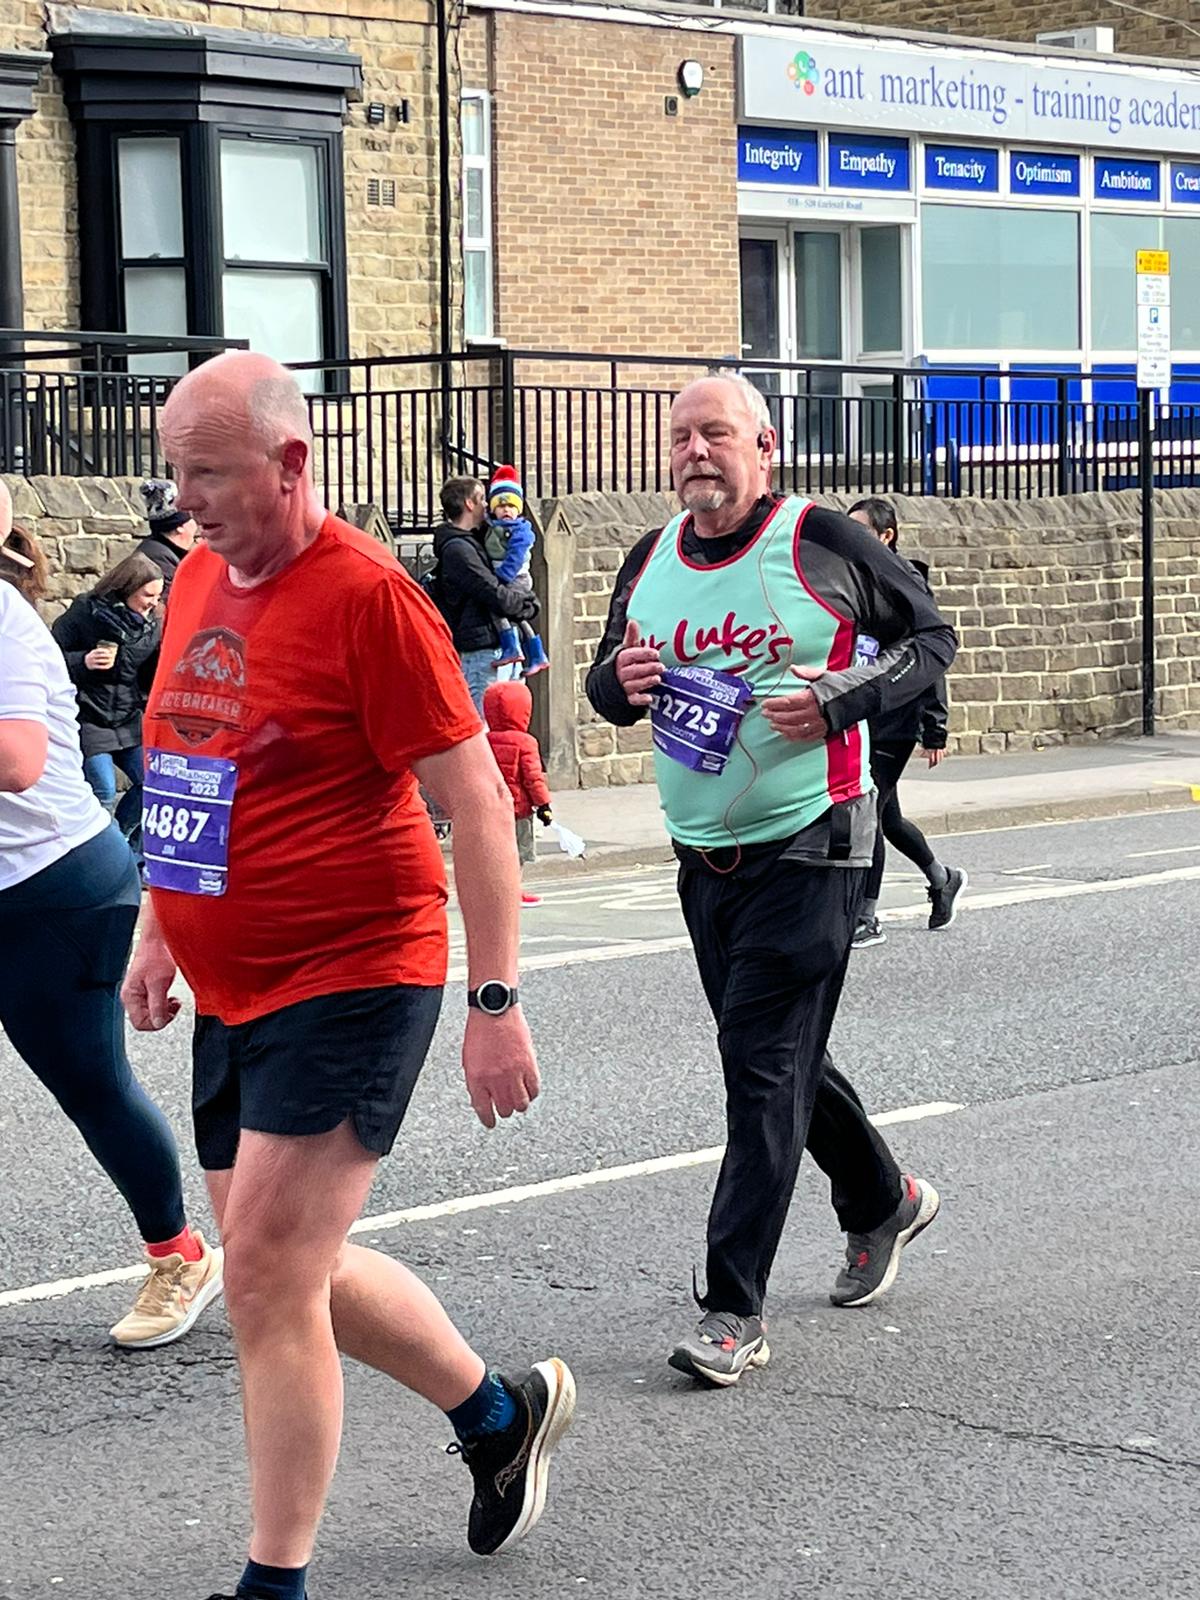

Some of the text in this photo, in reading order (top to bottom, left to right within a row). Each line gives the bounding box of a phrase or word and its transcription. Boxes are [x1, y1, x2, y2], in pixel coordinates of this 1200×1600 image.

[824, 64, 864, 100] ant
[880, 66, 1008, 124] marketing
[1033, 79, 1121, 134] training
[745, 143, 802, 171] Integrity
[840, 150, 896, 177] Empathy
[935, 156, 986, 183] Tenacity
[1016, 161, 1072, 186] Optimism
[1101, 170, 1152, 191] Ambition
[674, 611, 794, 663] Luke's
[161, 691, 241, 718] ICEBREAKER
[190, 782, 219, 797] 2023
